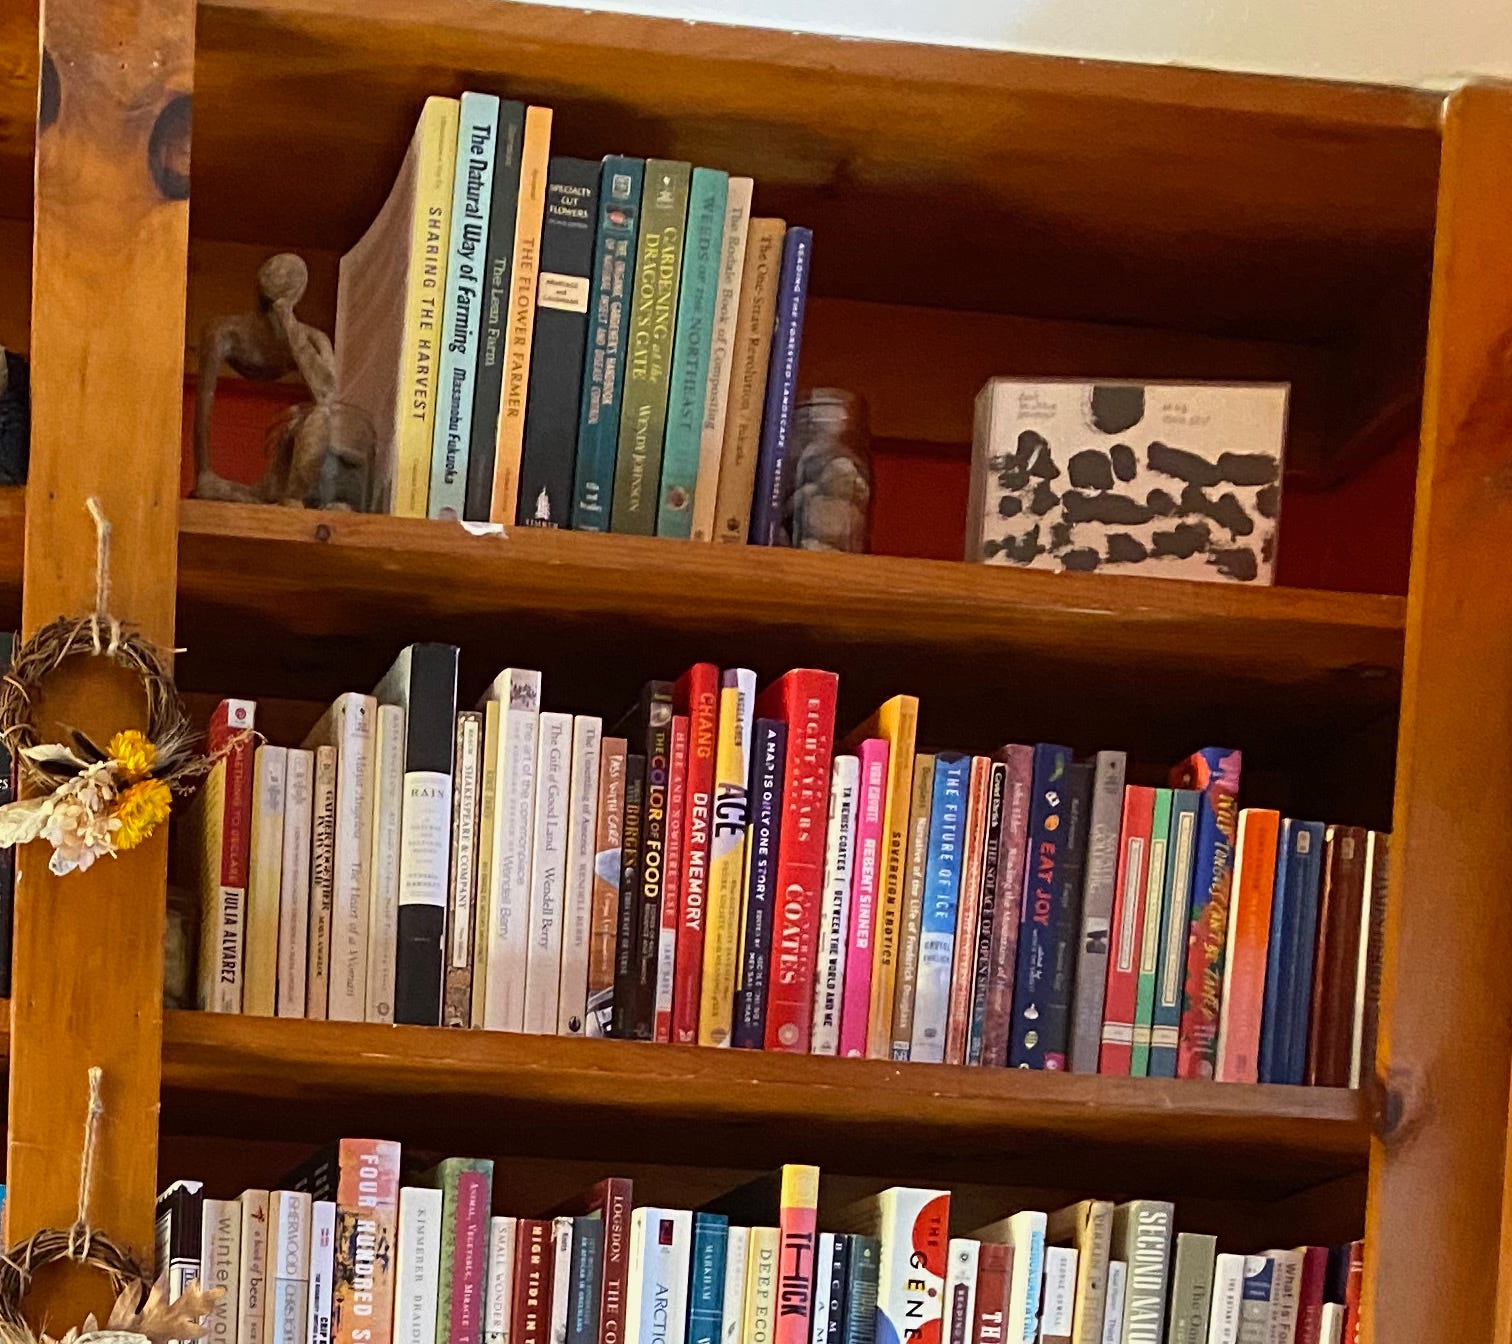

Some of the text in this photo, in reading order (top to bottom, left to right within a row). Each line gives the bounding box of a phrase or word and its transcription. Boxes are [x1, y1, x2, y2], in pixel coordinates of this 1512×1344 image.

[423, 207, 443, 288] SHARING
[449, 125, 490, 354] The Natural Way of Farming
[420, 298, 436, 330] THE
[484, 257, 506, 366] The Lean Farm
[412, 339, 432, 422] HARVEST
[444, 367, 467, 485] Masanobu Fukuoka
[697, 692, 713, 758] CHANG
[714, 783, 748, 838] ACE
[685, 793, 708, 931] DEAR MEMORY
[1033, 842, 1056, 926] EAT JOY
[359, 1153, 379, 1207] FOUR
[353, 1220, 375, 1317] HUNDRED
[1134, 1211, 1168, 1289] SECOND
[903, 1250, 928, 1339] GENE
